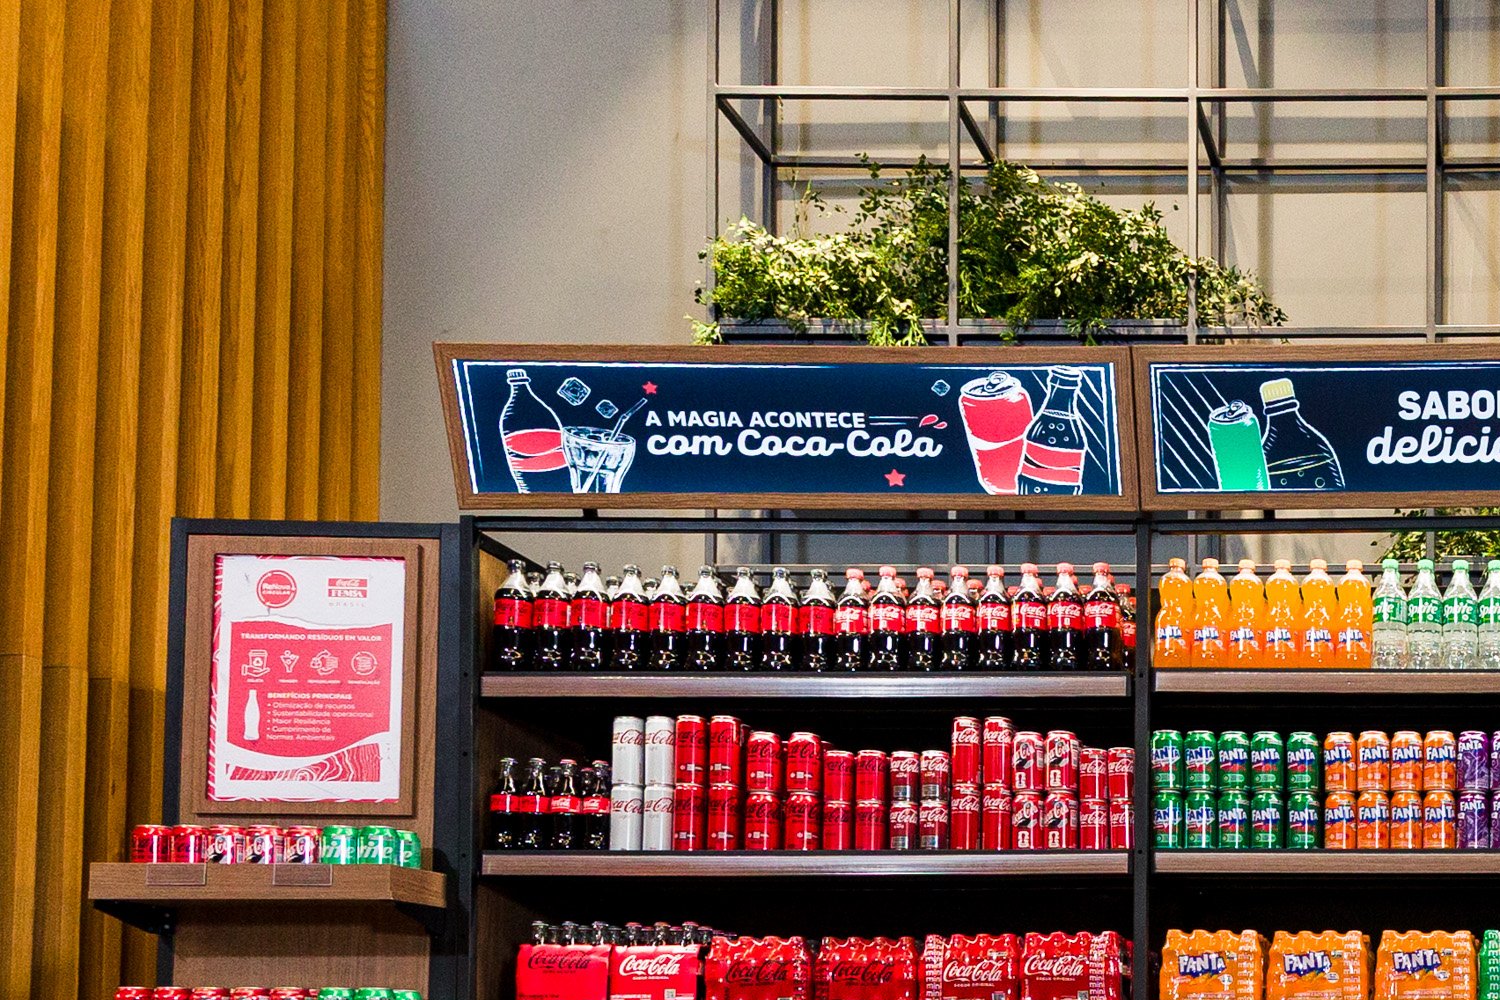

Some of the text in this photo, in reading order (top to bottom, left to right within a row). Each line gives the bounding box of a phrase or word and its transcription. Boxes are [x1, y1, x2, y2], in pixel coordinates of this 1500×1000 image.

[646, 411, 866, 428] A MAGIA ACONTECE
[647, 430, 943, 458] com Coca-Cola
[1219, 748, 1248, 763] FANTA
[1252, 748, 1280, 763] FANTA
[1288, 749, 1315, 764] FANTA
[619, 954, 684, 976] Coca-Cola
[943, 960, 1006, 982] Coca-Cola
[1024, 954, 1090, 976] Coca-Cola
[1179, 953, 1226, 974] FANTA
[1285, 953, 1331, 973] FANTA
[1394, 950, 1441, 971] FANTA
